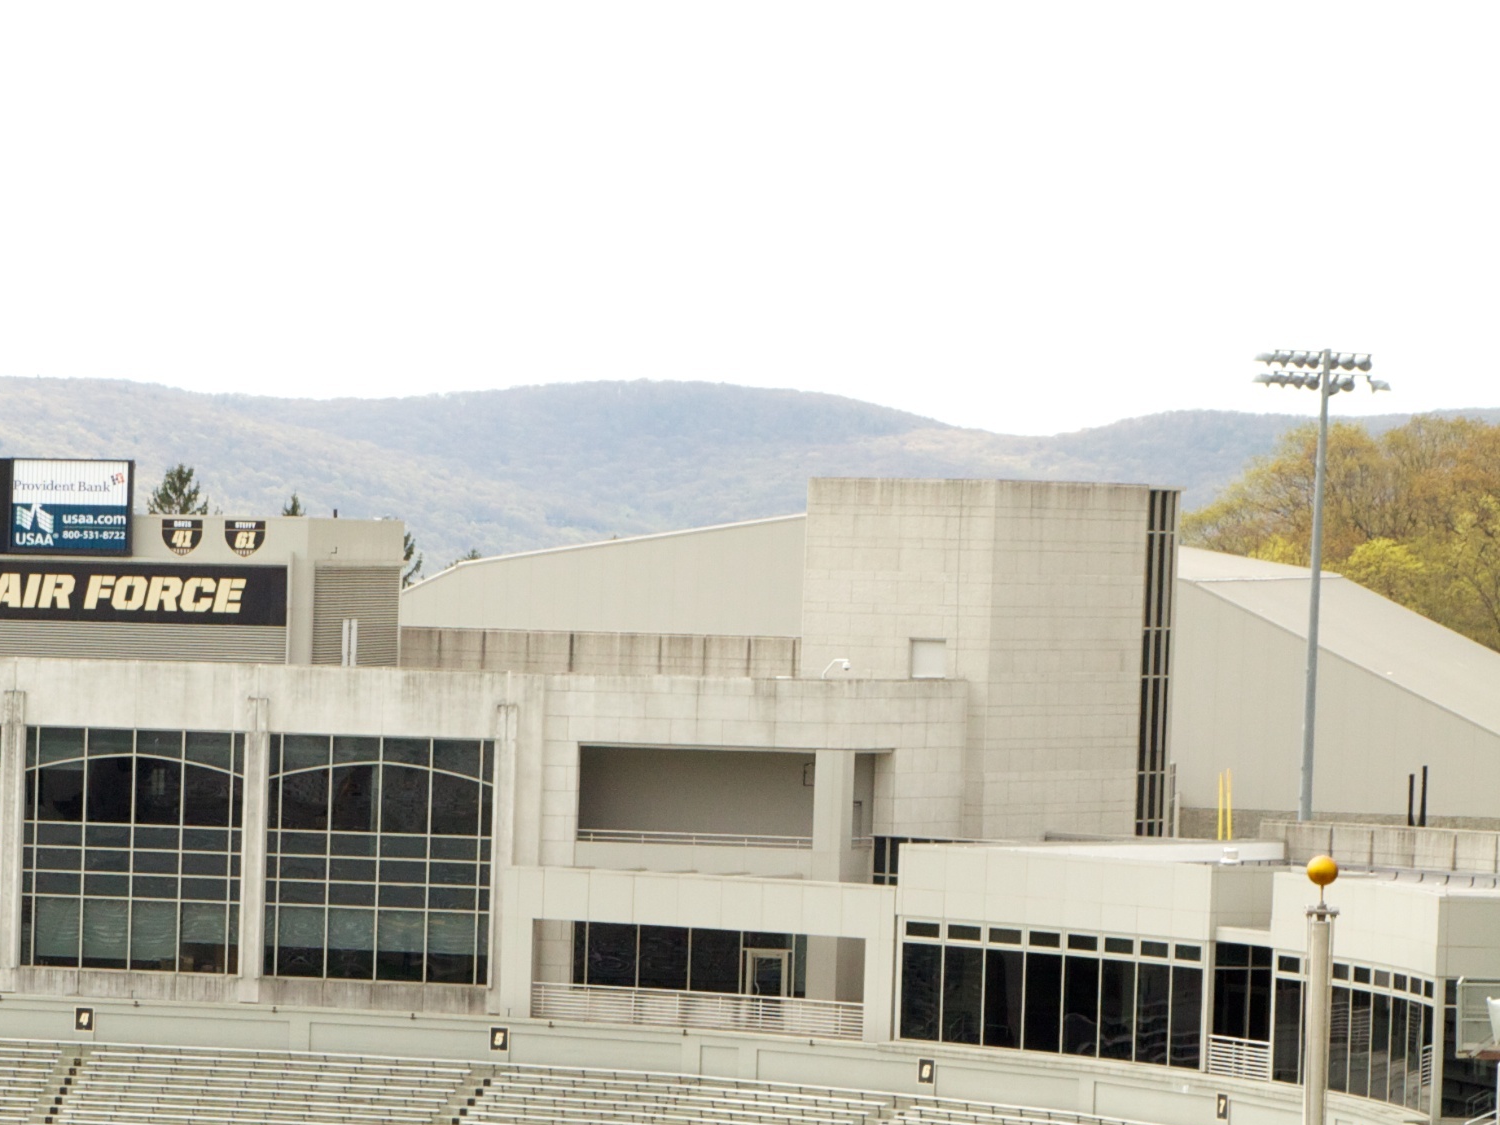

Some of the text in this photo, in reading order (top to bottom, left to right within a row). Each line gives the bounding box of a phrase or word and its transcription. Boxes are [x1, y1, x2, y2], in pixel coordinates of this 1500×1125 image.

[13, 480, 110, 492] Provident Bank
[62, 514, 126, 525] usaa.com
[15, 533, 54, 546] USAA
[62, 530, 125, 540] 800-531-8722
[171, 530, 193, 548] 41
[234, 531, 256, 549] 61
[83, 574, 247, 614] FORCE
[79, 1012, 89, 1025] 4
[494, 1032, 504, 1045] 5
[922, 1065, 931, 1078] 6
[1219, 1099, 1225, 1113] 7
